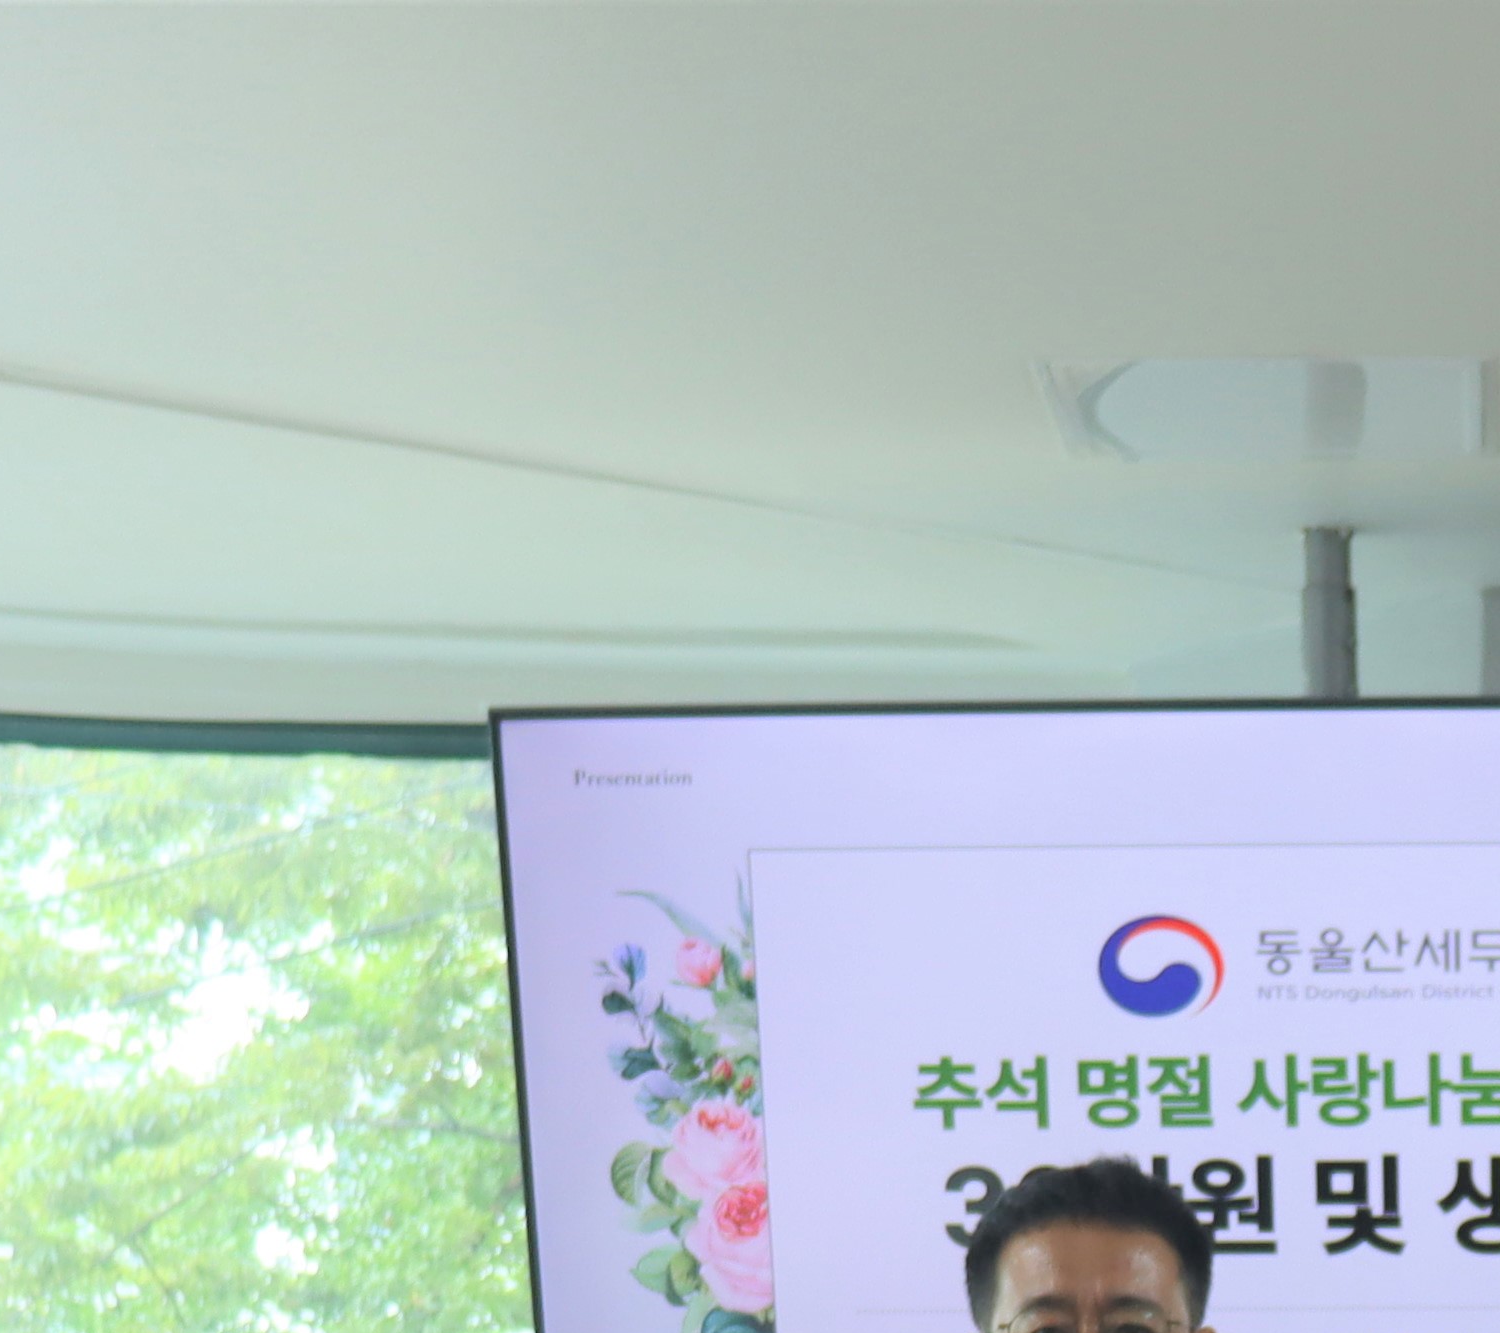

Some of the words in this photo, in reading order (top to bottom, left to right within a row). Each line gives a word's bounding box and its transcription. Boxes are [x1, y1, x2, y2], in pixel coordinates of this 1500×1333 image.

[573, 767, 693, 787] Presentation
[1257, 985, 1298, 1001] NTS
[1305, 983, 1414, 1003] Dongulsan
[1422, 983, 1494, 1000] District
[913, 1055, 1051, 1130] 추석
[1076, 1053, 1215, 1129] 명절
[1314, 1153, 1407, 1255] 및
